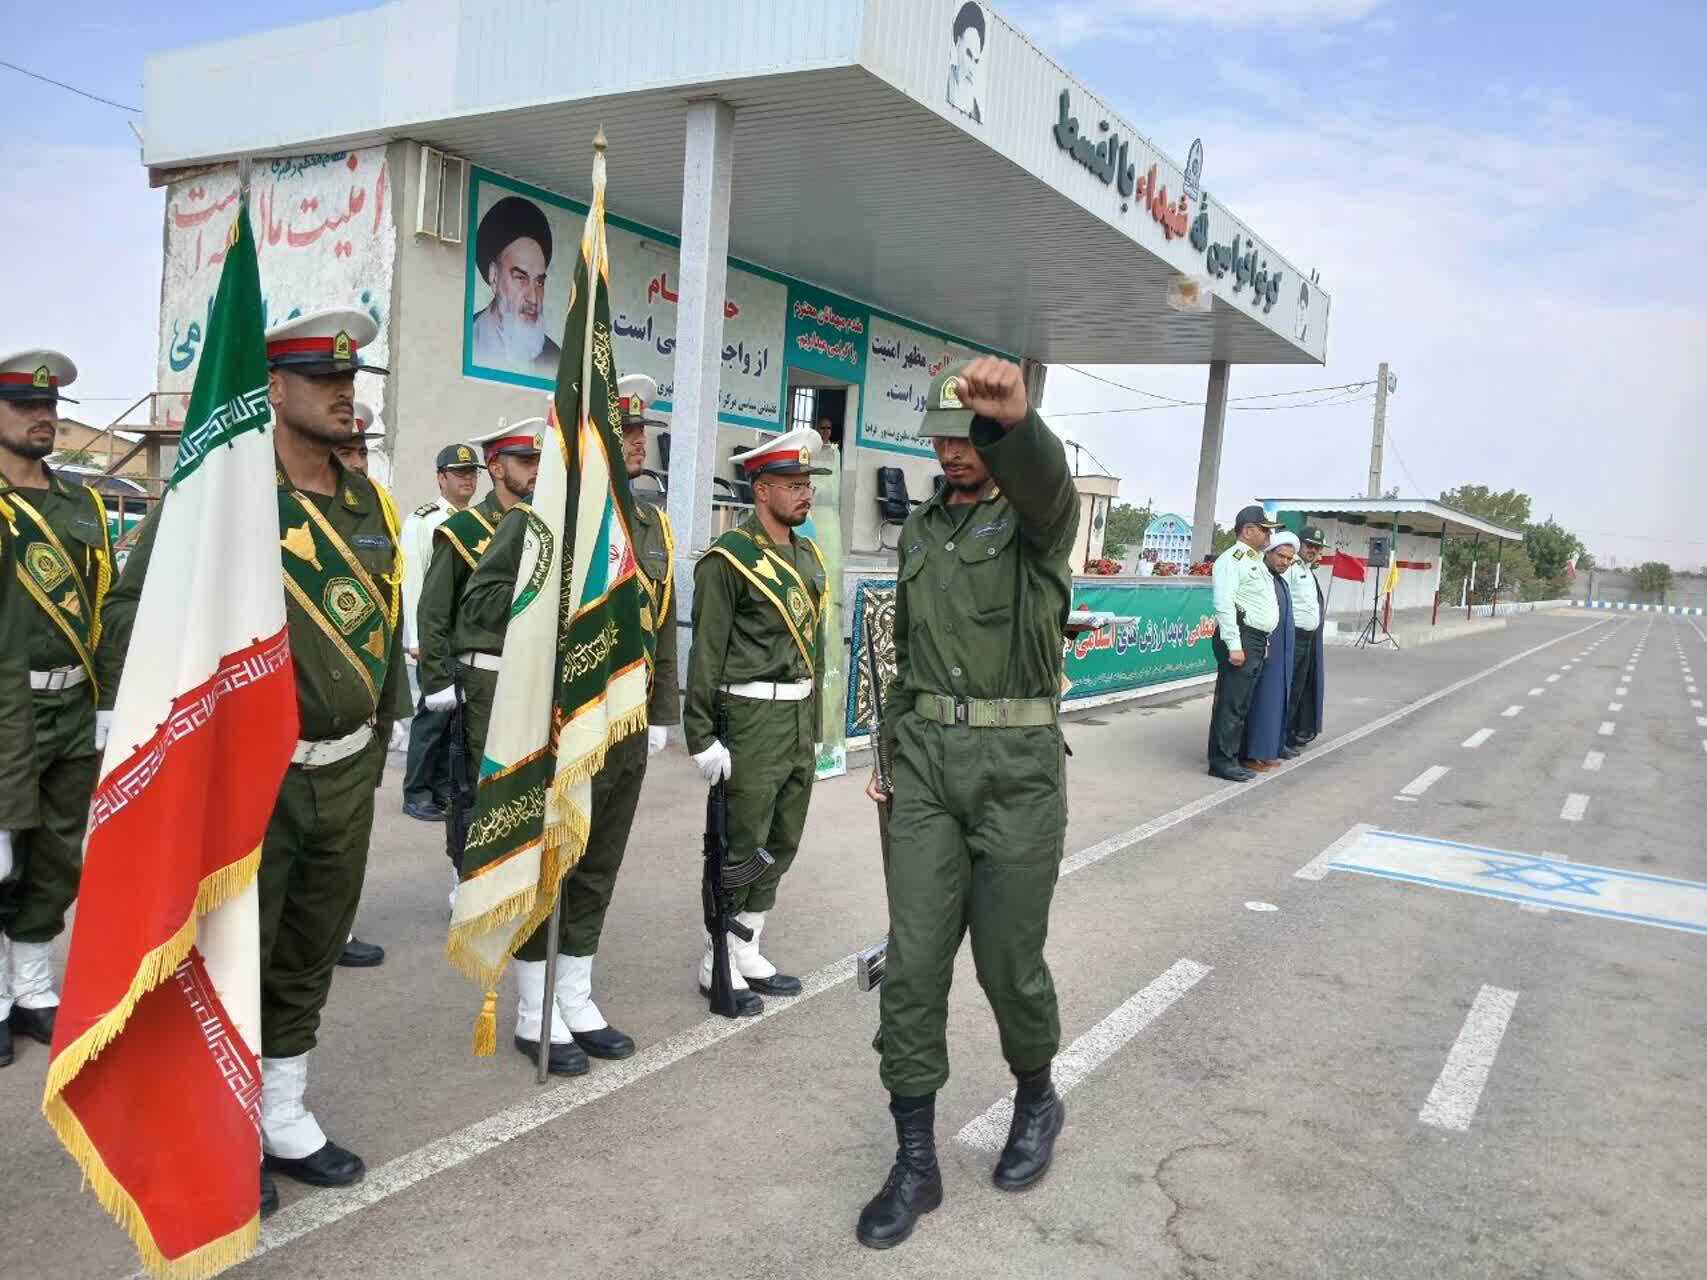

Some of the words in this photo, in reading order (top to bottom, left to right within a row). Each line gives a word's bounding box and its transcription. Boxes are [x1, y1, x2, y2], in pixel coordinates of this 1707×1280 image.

[1053, 88, 1135, 214] بالقسط
[1135, 162, 1189, 241] شهداء
[753, 347, 769, 377] از
[871, 336, 900, 363] امنیت
[902, 344, 927, 369] مظهر
